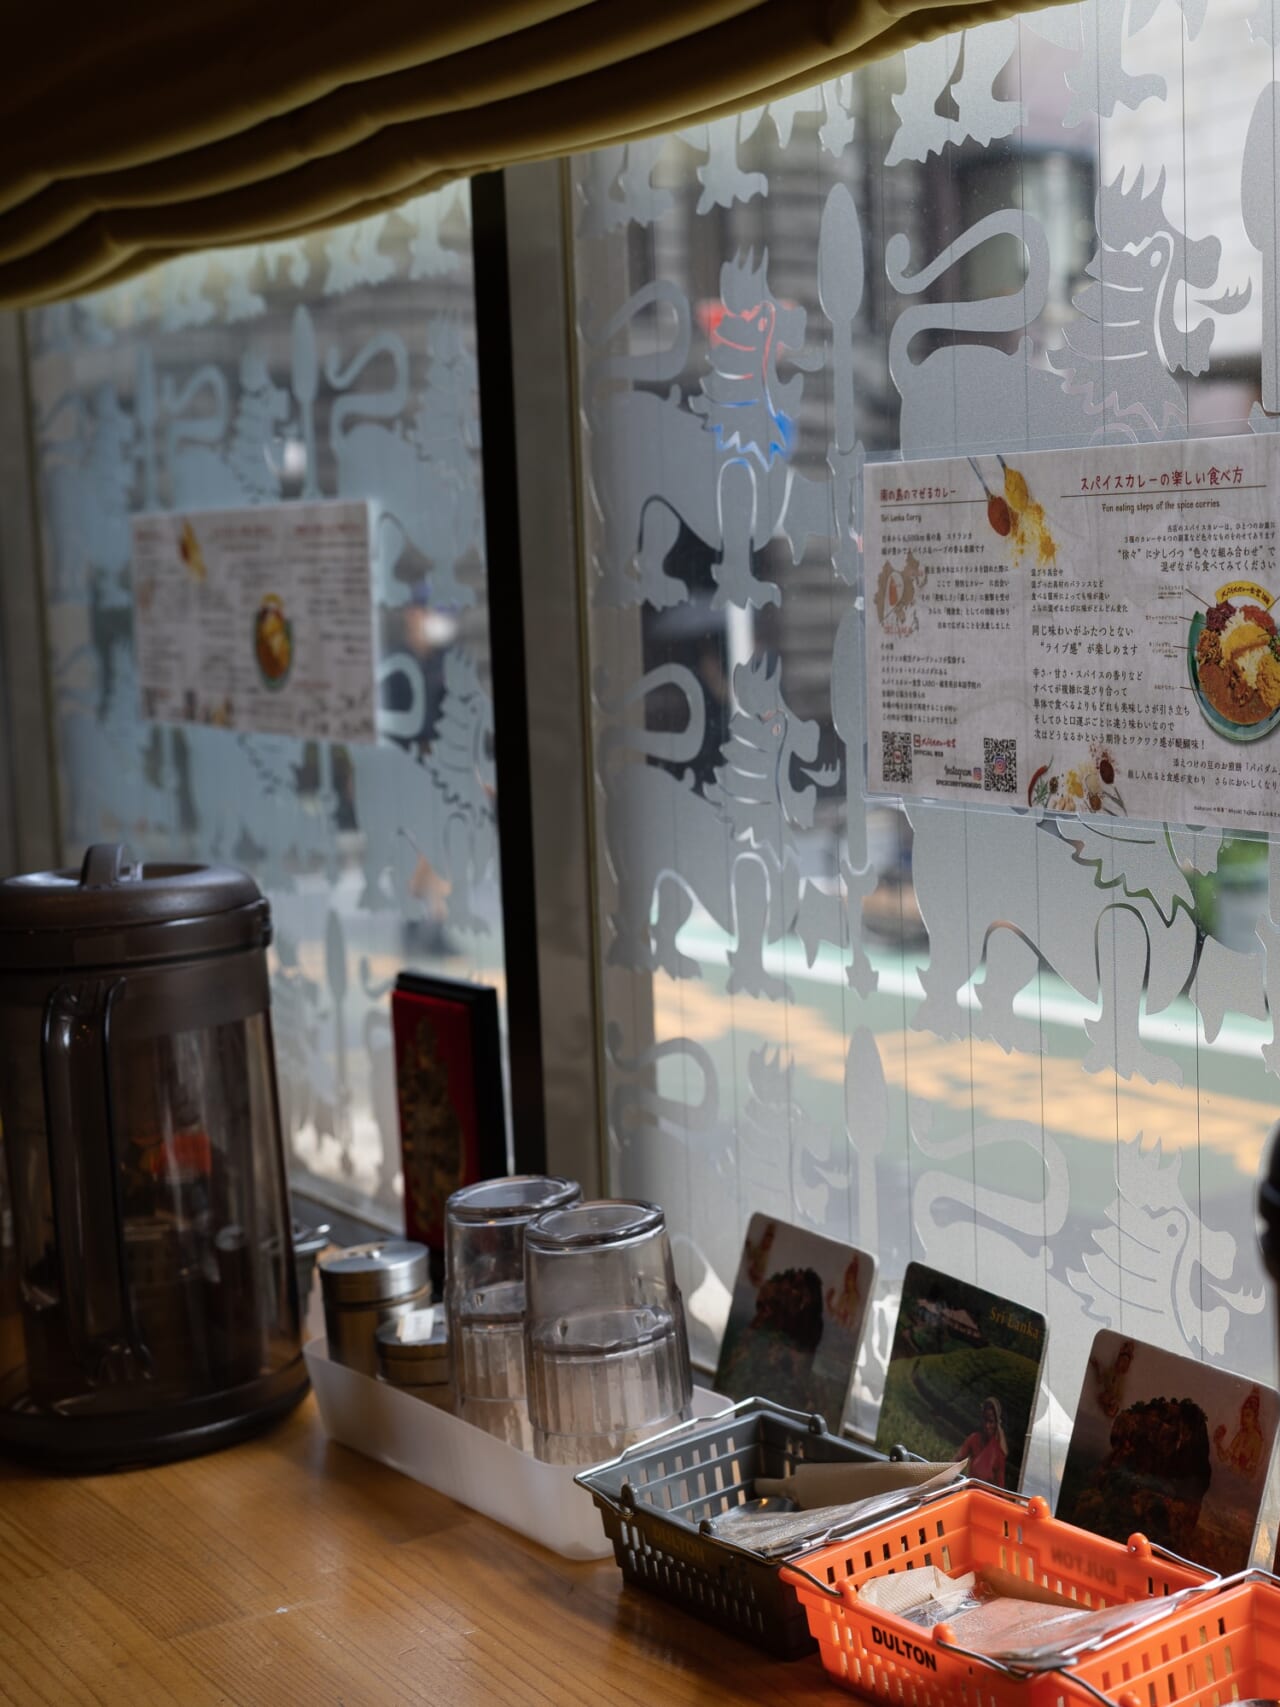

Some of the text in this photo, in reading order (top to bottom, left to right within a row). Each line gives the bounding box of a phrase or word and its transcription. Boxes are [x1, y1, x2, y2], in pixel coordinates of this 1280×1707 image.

[1081, 466, 1244, 491] スパイスカレーの楽しい食べ方
[1102, 499, 1220, 515] Fun eating steps of the spice curries
[1160, 559, 1277, 573] 混ぜながら食べてみてください
[1032, 624, 1134, 638] 同じ味わいがふたつとない
[1087, 643, 1139, 656] が楽しめます
[1032, 683, 1128, 697] すべてが複雑に混ざり合って
[990, 1306, 1040, 1340] Sri Lanka
[871, 1625, 937, 1672] DULTON
